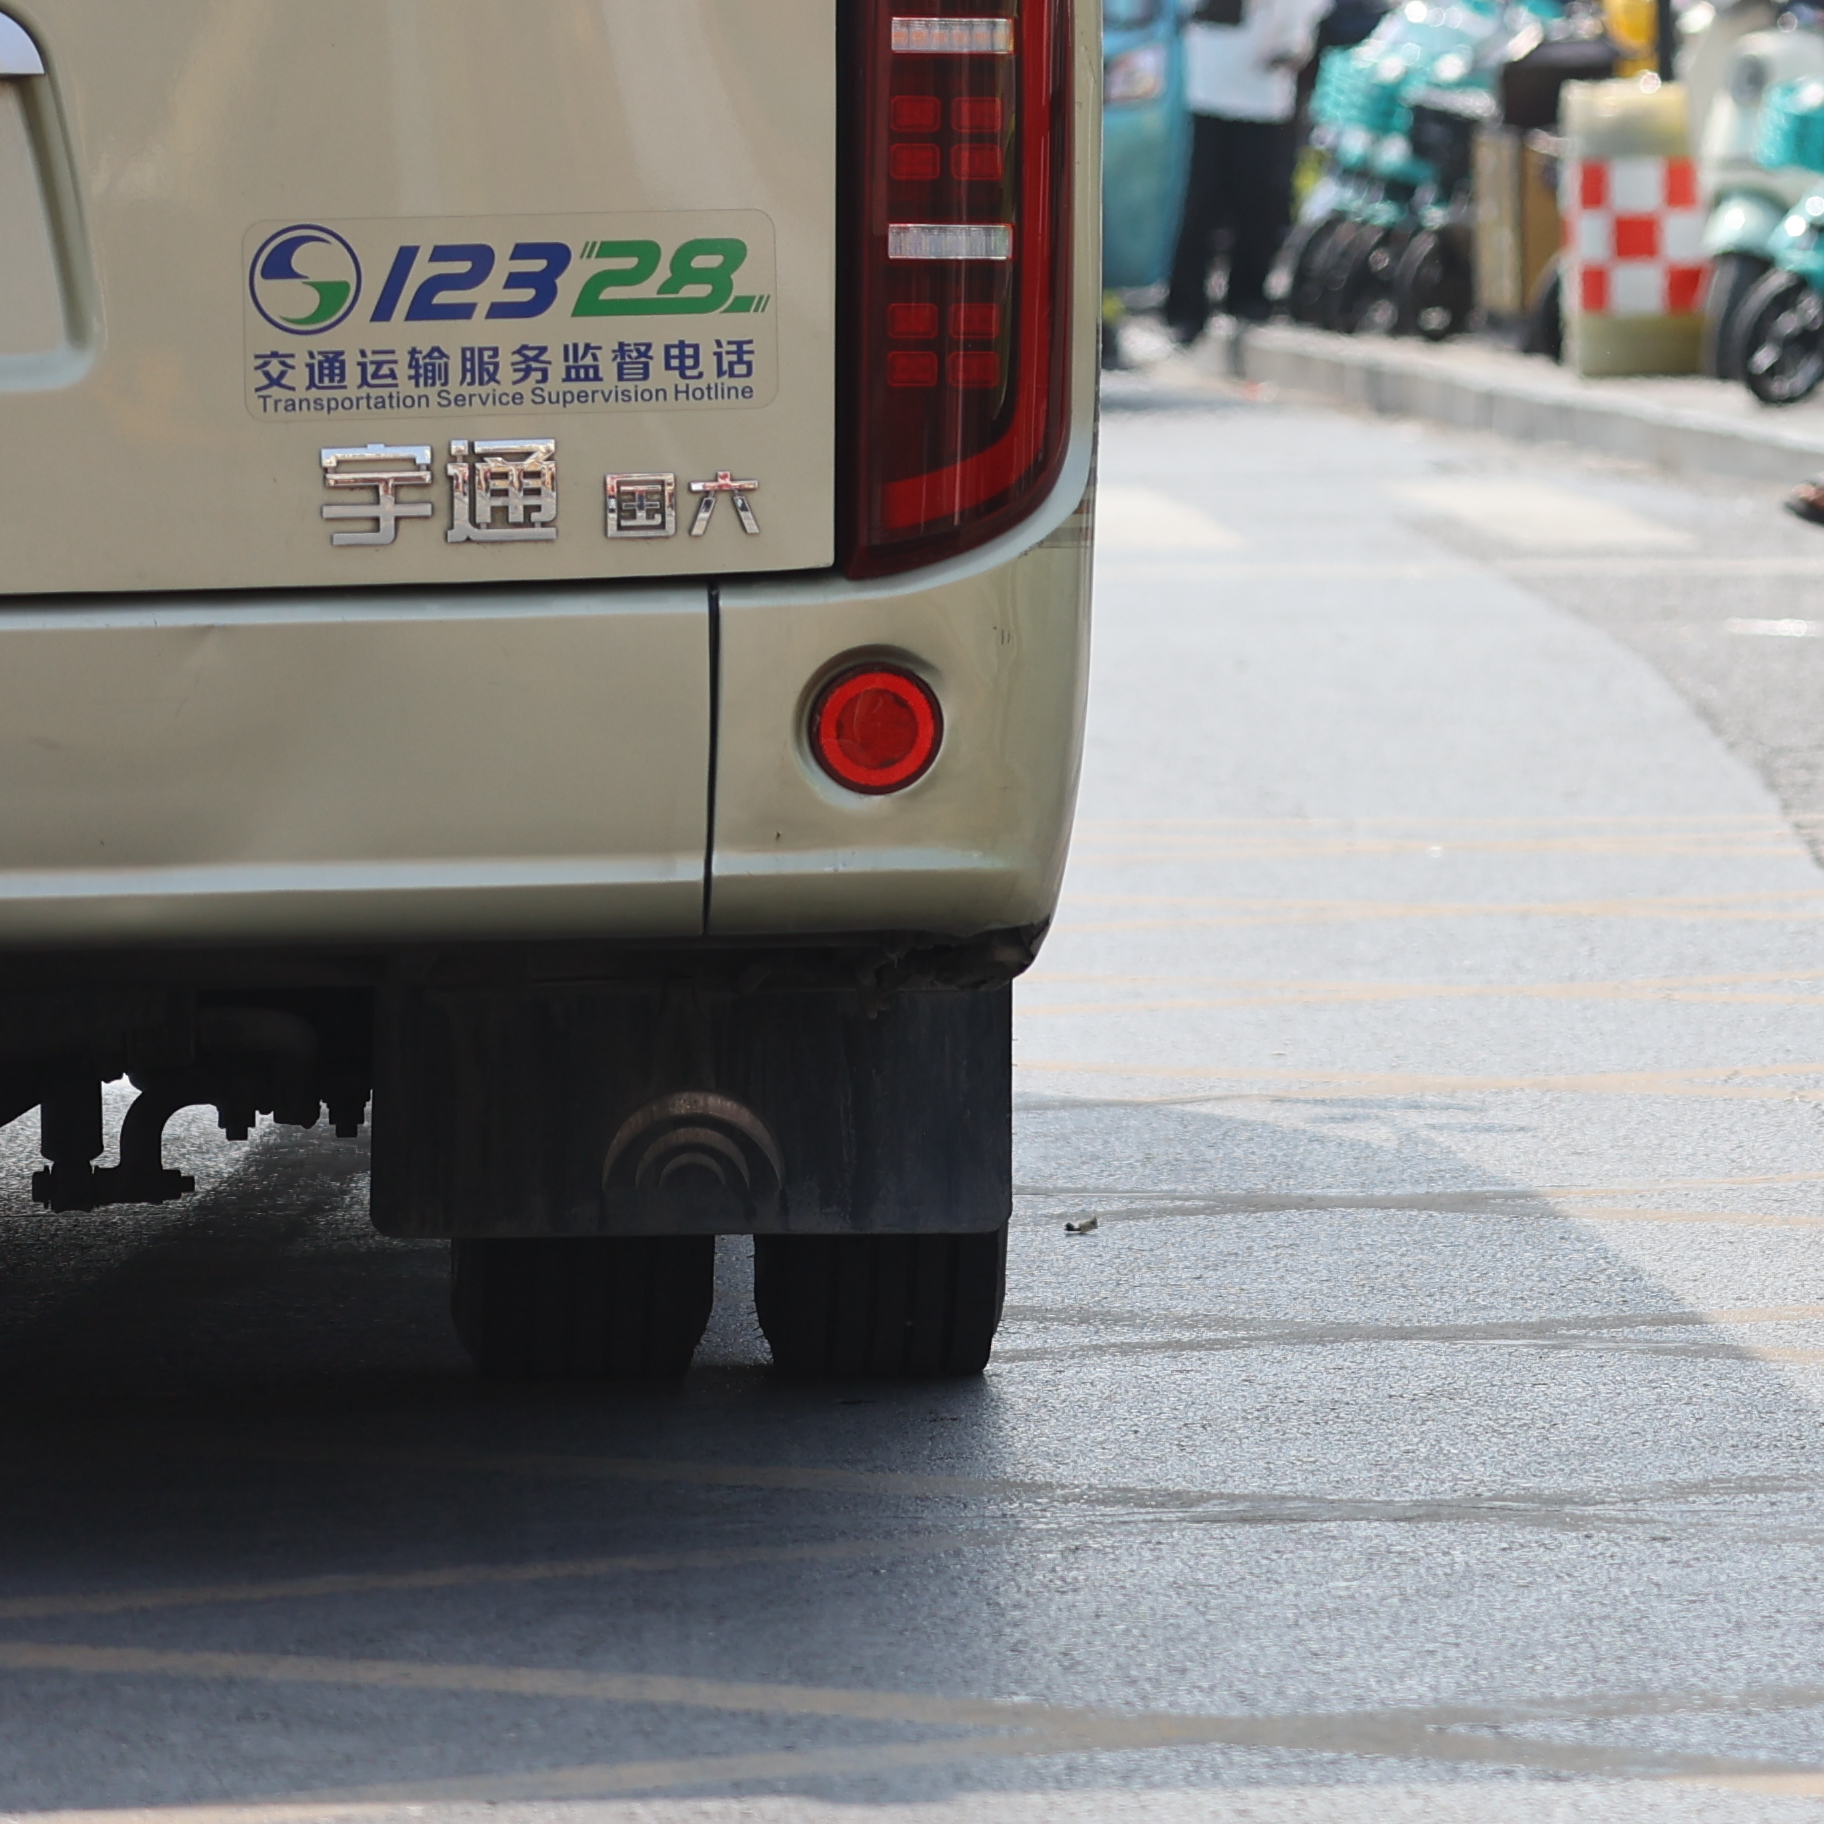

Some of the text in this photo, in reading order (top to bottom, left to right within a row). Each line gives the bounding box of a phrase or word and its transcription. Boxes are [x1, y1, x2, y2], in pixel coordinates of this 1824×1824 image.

[370, 238, 762, 323] 12328
[254, 338, 755, 393] 交通运输服务监督电话
[257, 382, 754, 415] Transportation Service Supervision Hotline
[320, 438, 558, 546] 宇通
[605, 471, 761, 538] 国六
